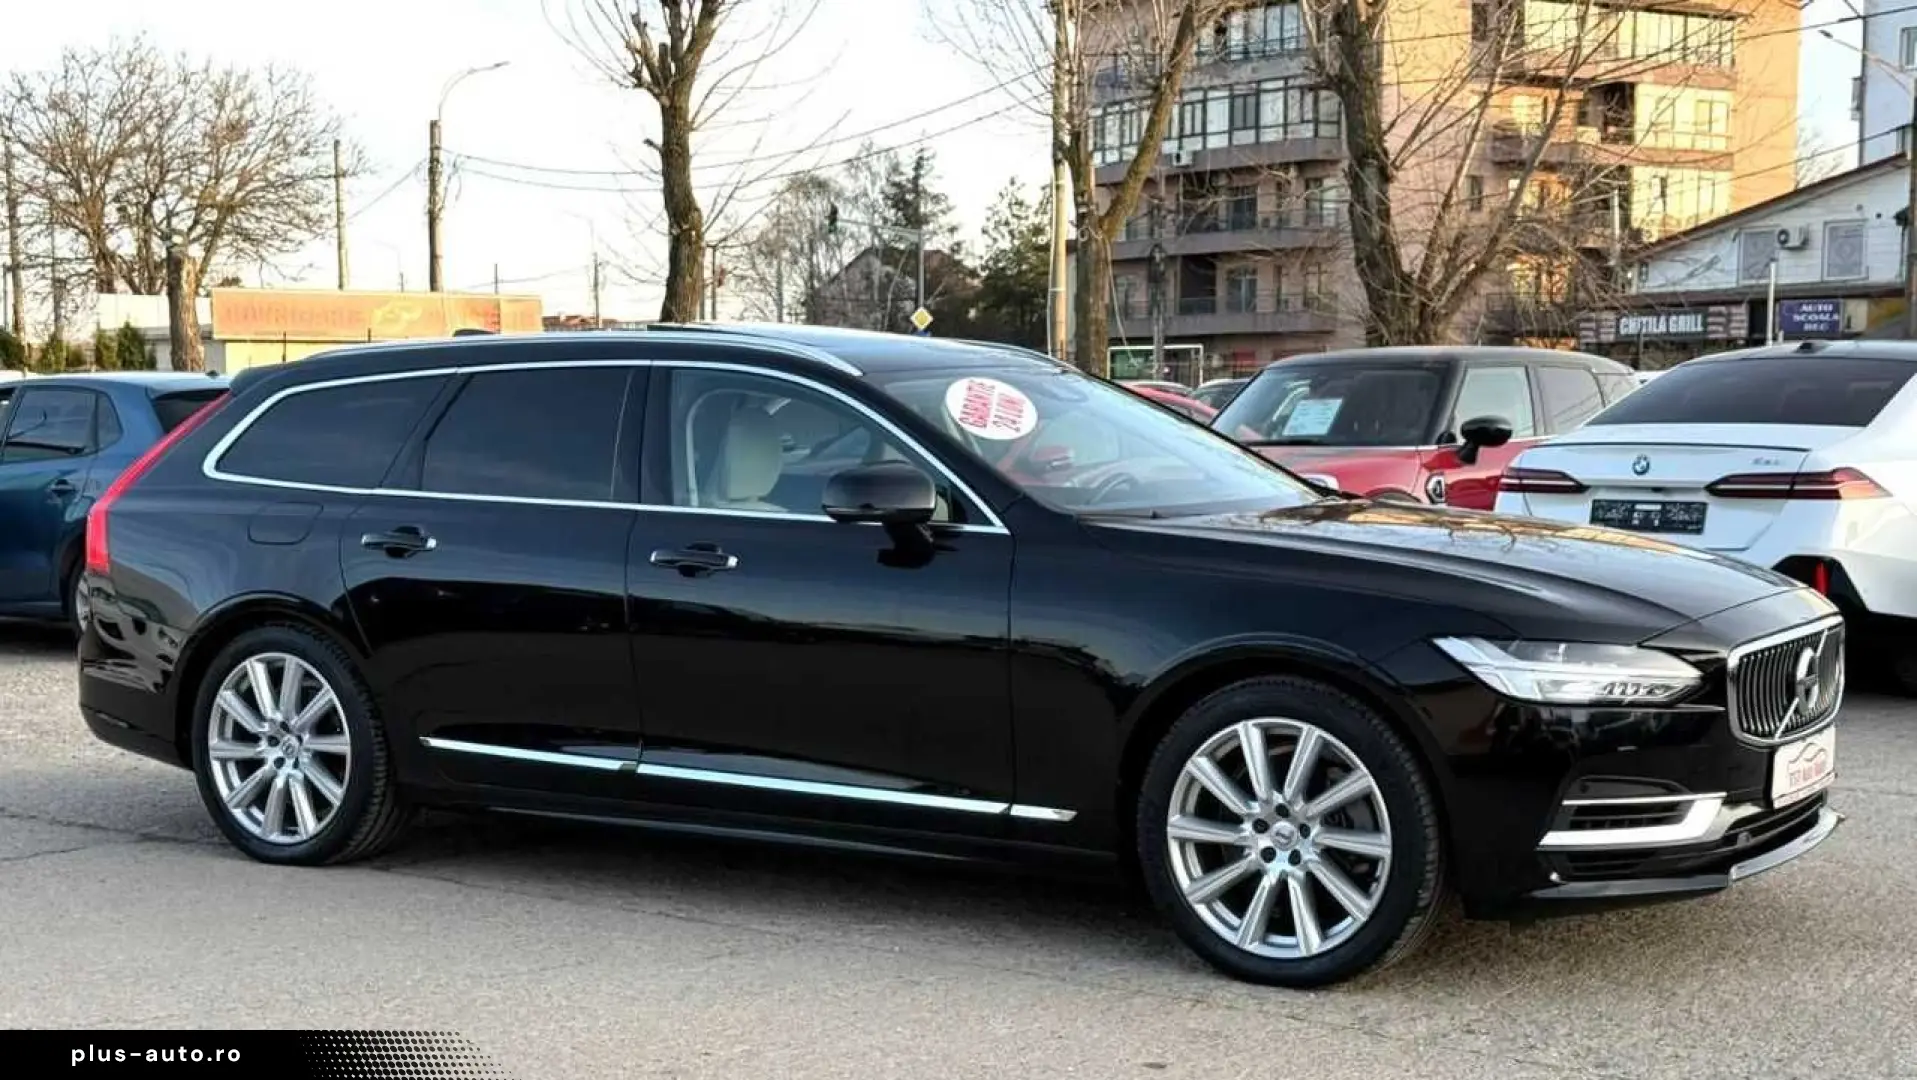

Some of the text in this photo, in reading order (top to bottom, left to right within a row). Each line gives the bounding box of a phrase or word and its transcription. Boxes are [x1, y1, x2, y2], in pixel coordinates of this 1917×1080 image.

[1800, 303, 1833, 312] AUTO
[1620, 314, 1703, 334] CHITILA GRILL
